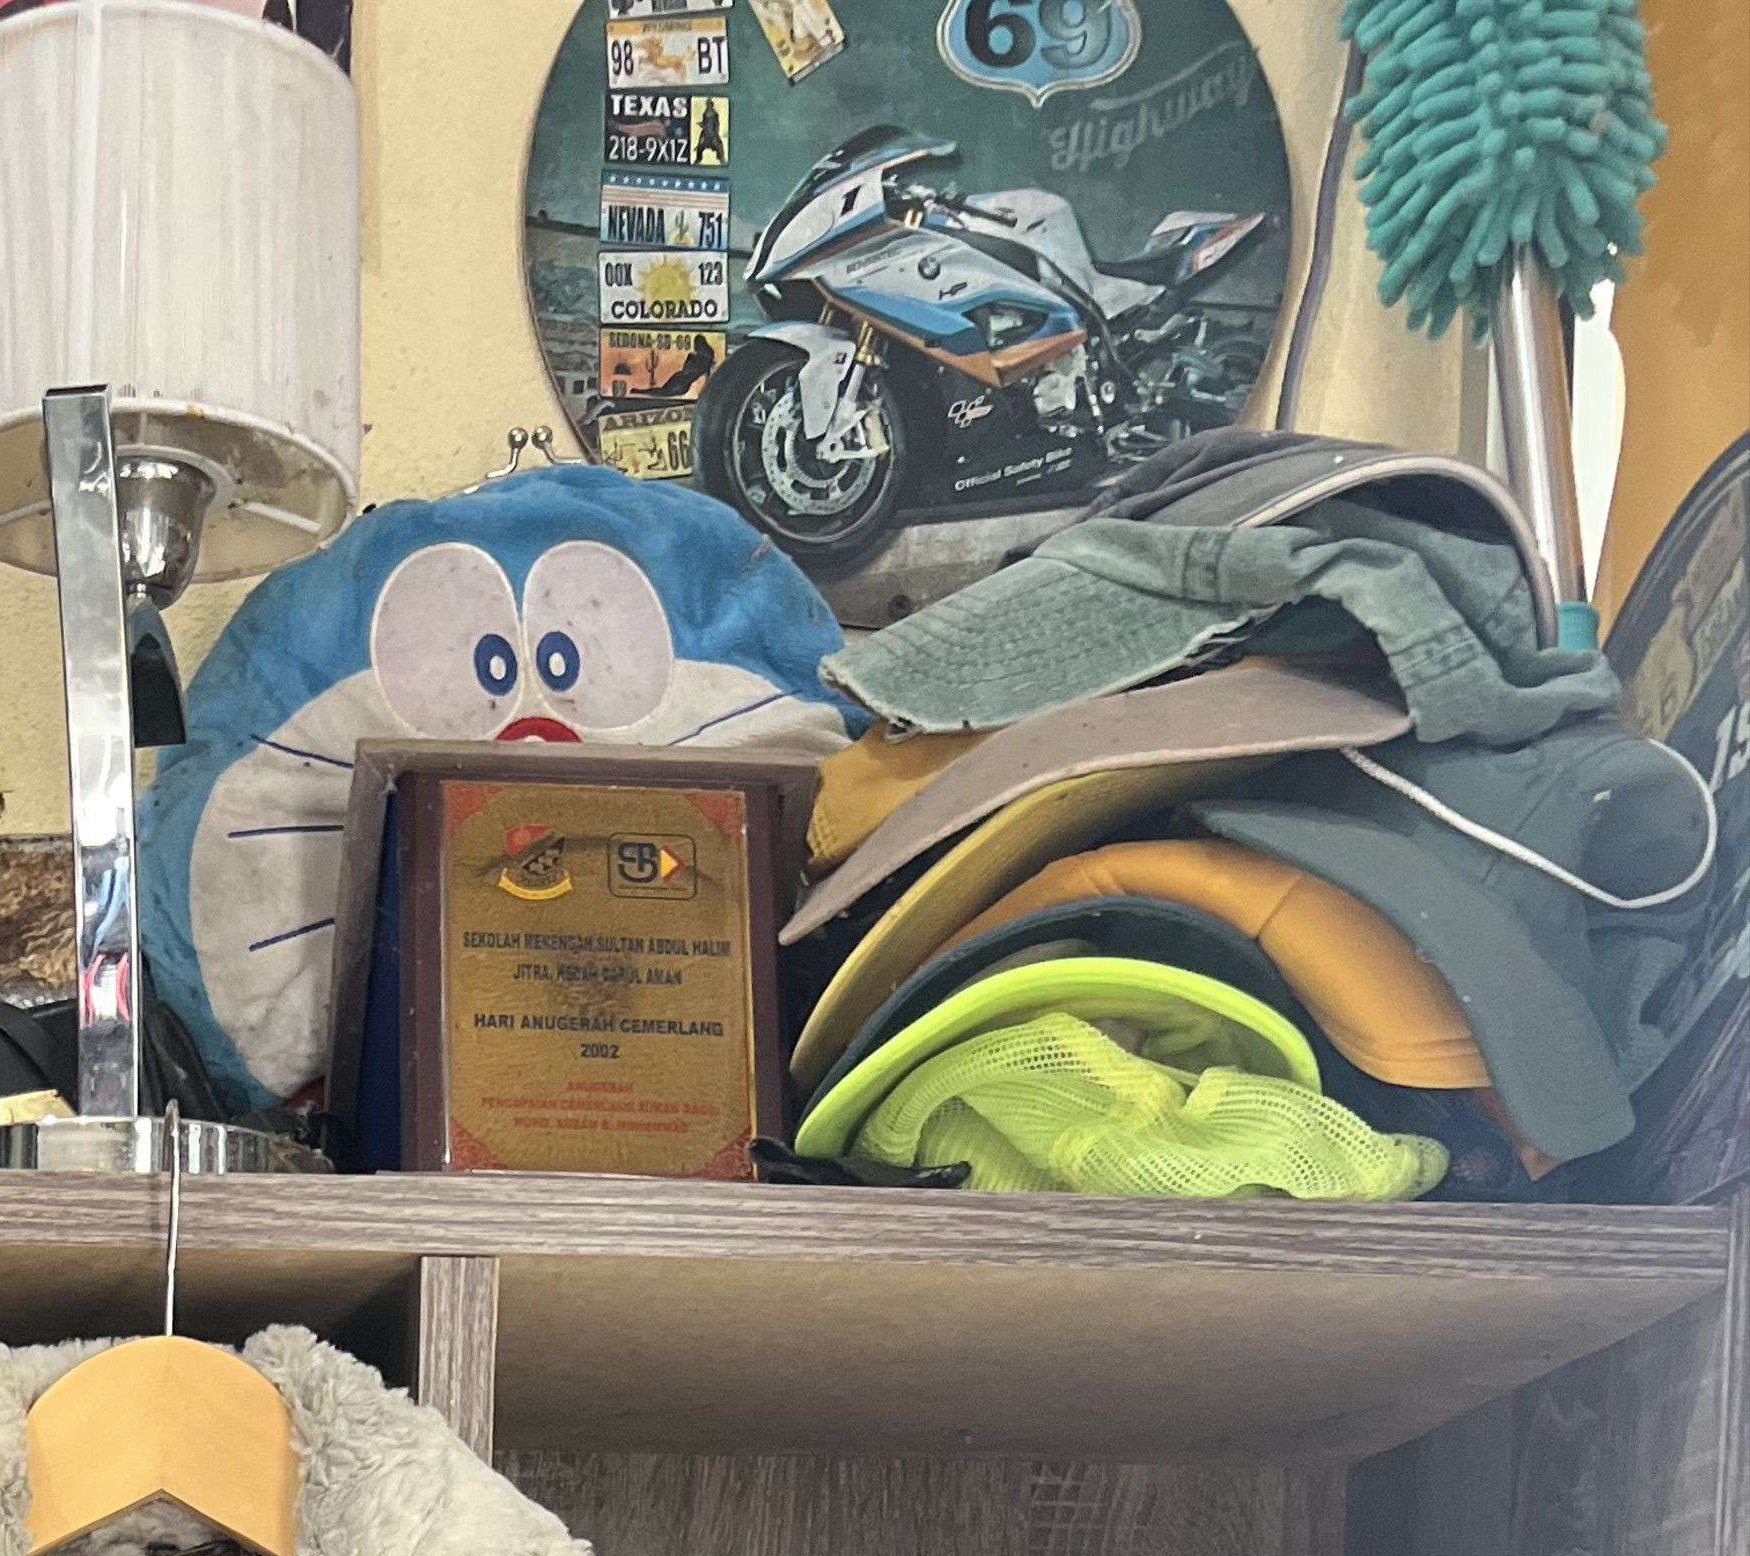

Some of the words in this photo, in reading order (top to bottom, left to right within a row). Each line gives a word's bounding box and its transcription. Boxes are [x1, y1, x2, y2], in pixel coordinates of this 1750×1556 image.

[964, 0, 1112, 69] 69
[611, 39, 634, 76] 98
[697, 36, 727, 74] BT
[611, 94, 688, 118] TEXAS
[1048, 46, 1251, 172] Highway
[608, 205, 665, 243] NEVADA
[699, 211, 723, 248] 751
[699, 261, 723, 286] 123
[611, 299, 718, 319] COLORADO
[463, 931, 521, 949] SEKOLAH
[474, 1013, 514, 1029] HARI
[520, 1015, 613, 1033] ANUGERAH
[619, 1018, 724, 1037] CEMERLANG
[580, 1043, 620, 1060] 2002
